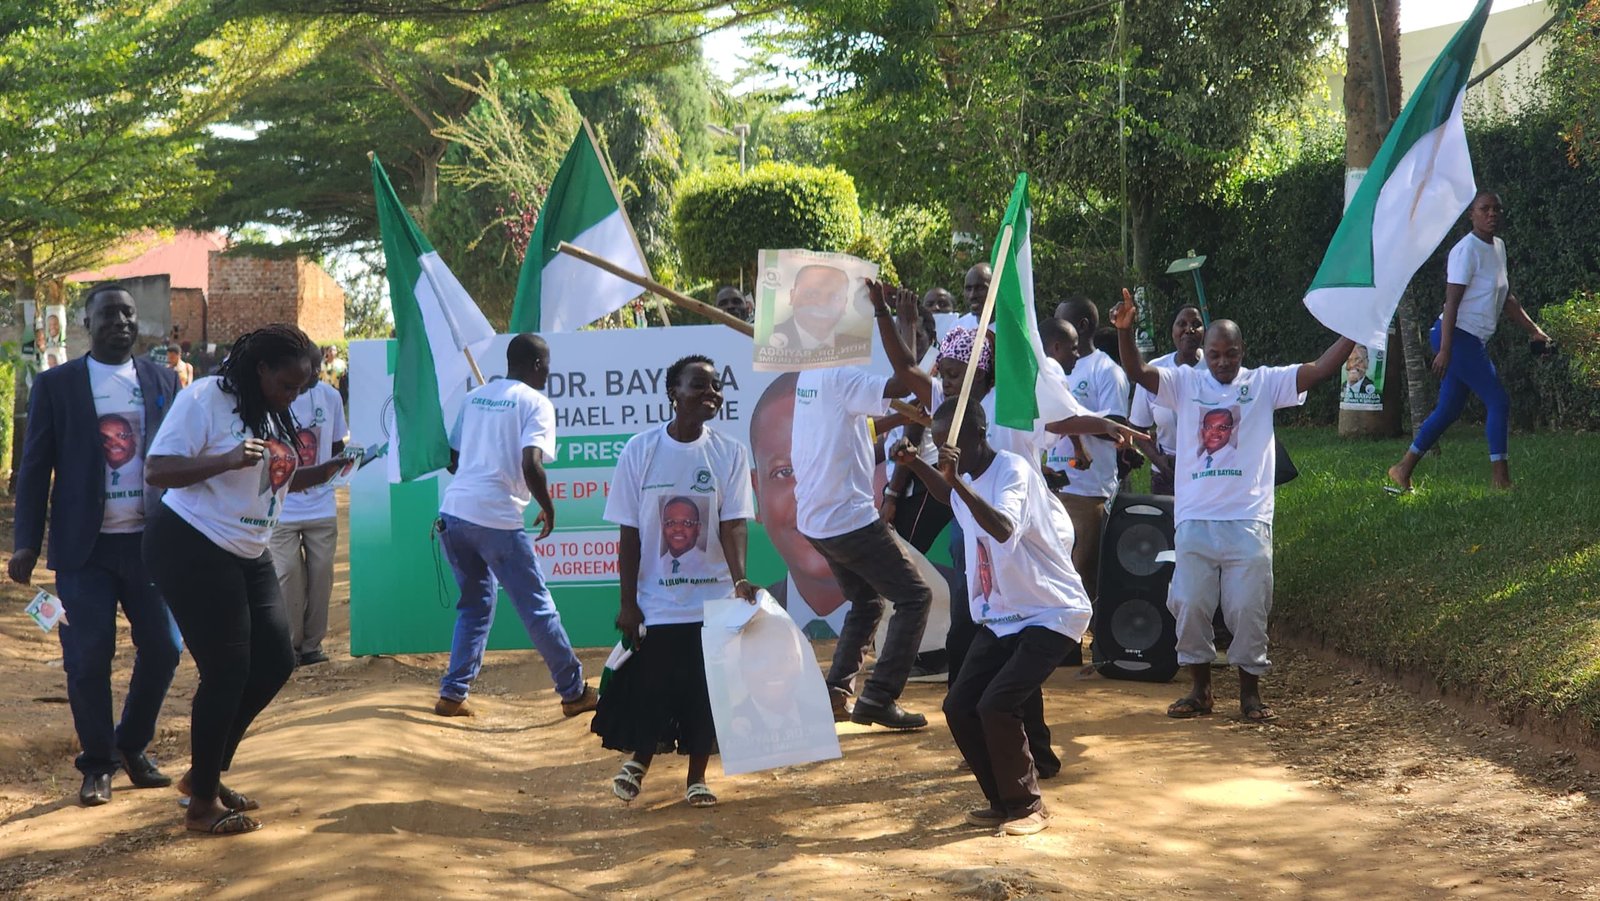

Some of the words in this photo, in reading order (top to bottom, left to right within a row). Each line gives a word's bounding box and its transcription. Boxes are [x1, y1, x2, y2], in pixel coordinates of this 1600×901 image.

[546, 372, 595, 399] DR.
[555, 406, 614, 427] HAEL
[621, 405, 638, 424] P.
[569, 441, 624, 461] PRES
[573, 482, 597, 499] DP
[534, 543, 555, 557] NO
[560, 542, 578, 556] TO
[583, 541, 621, 556] COO
[552, 560, 621, 575] AGREEM
